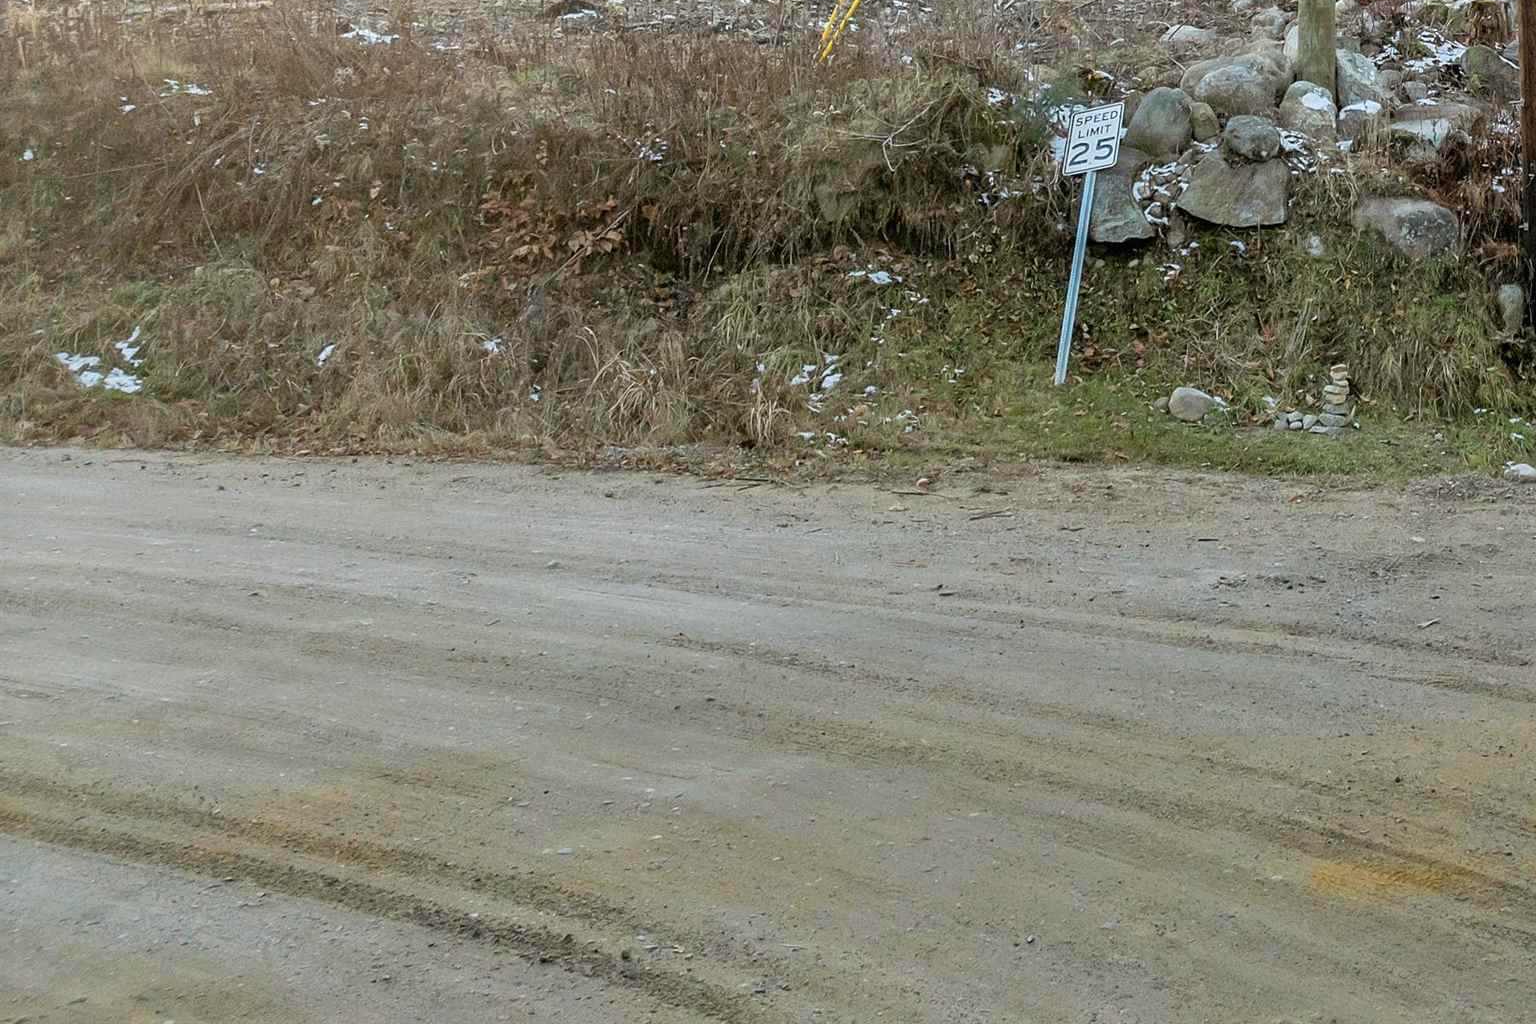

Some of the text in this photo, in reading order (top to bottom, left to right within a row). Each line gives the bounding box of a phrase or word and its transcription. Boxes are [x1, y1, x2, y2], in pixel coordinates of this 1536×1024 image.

[1075, 110, 1118, 127] SPEED
[1077, 124, 1112, 139] LIMIT
[1068, 136, 1115, 166] 25
